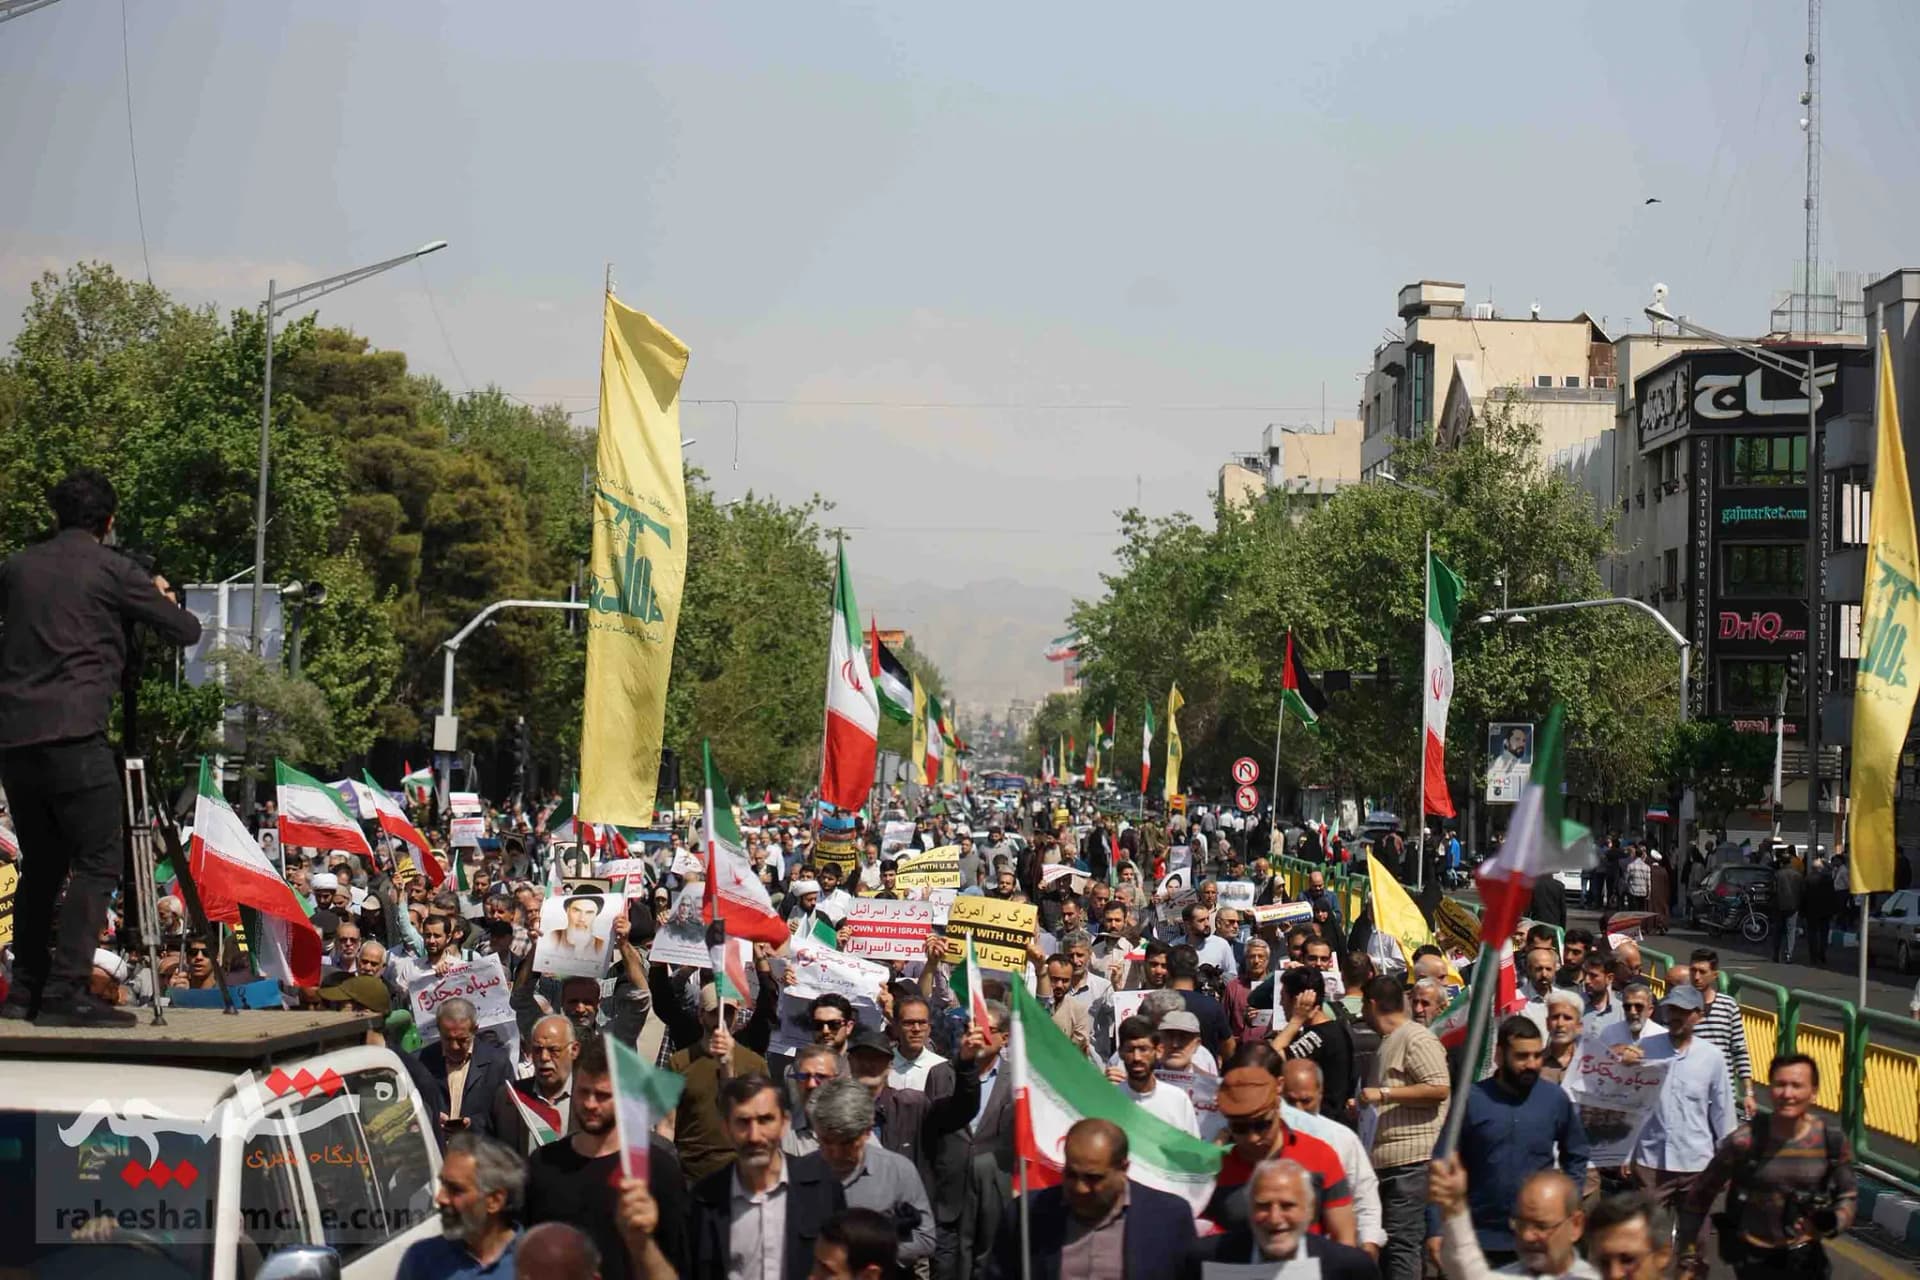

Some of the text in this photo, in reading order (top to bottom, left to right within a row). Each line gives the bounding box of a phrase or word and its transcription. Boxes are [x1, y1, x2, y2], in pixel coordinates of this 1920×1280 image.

[1722, 506, 1808, 523] gajmarket.com
[1698, 478, 1707, 579] NATIONWIDE
[1719, 611, 1806, 643] DriQ.com
[891, 910, 901, 919] بر
[905, 904, 929, 920] مرگ
[988, 912, 1001, 924] بر
[1007, 909, 1033, 927] مرگ
[875, 926, 897, 934] WITH
[899, 927, 927, 935] ISRAEL
[976, 928, 1005, 941] WITH
[466, 974, 500, 998] سپاه
